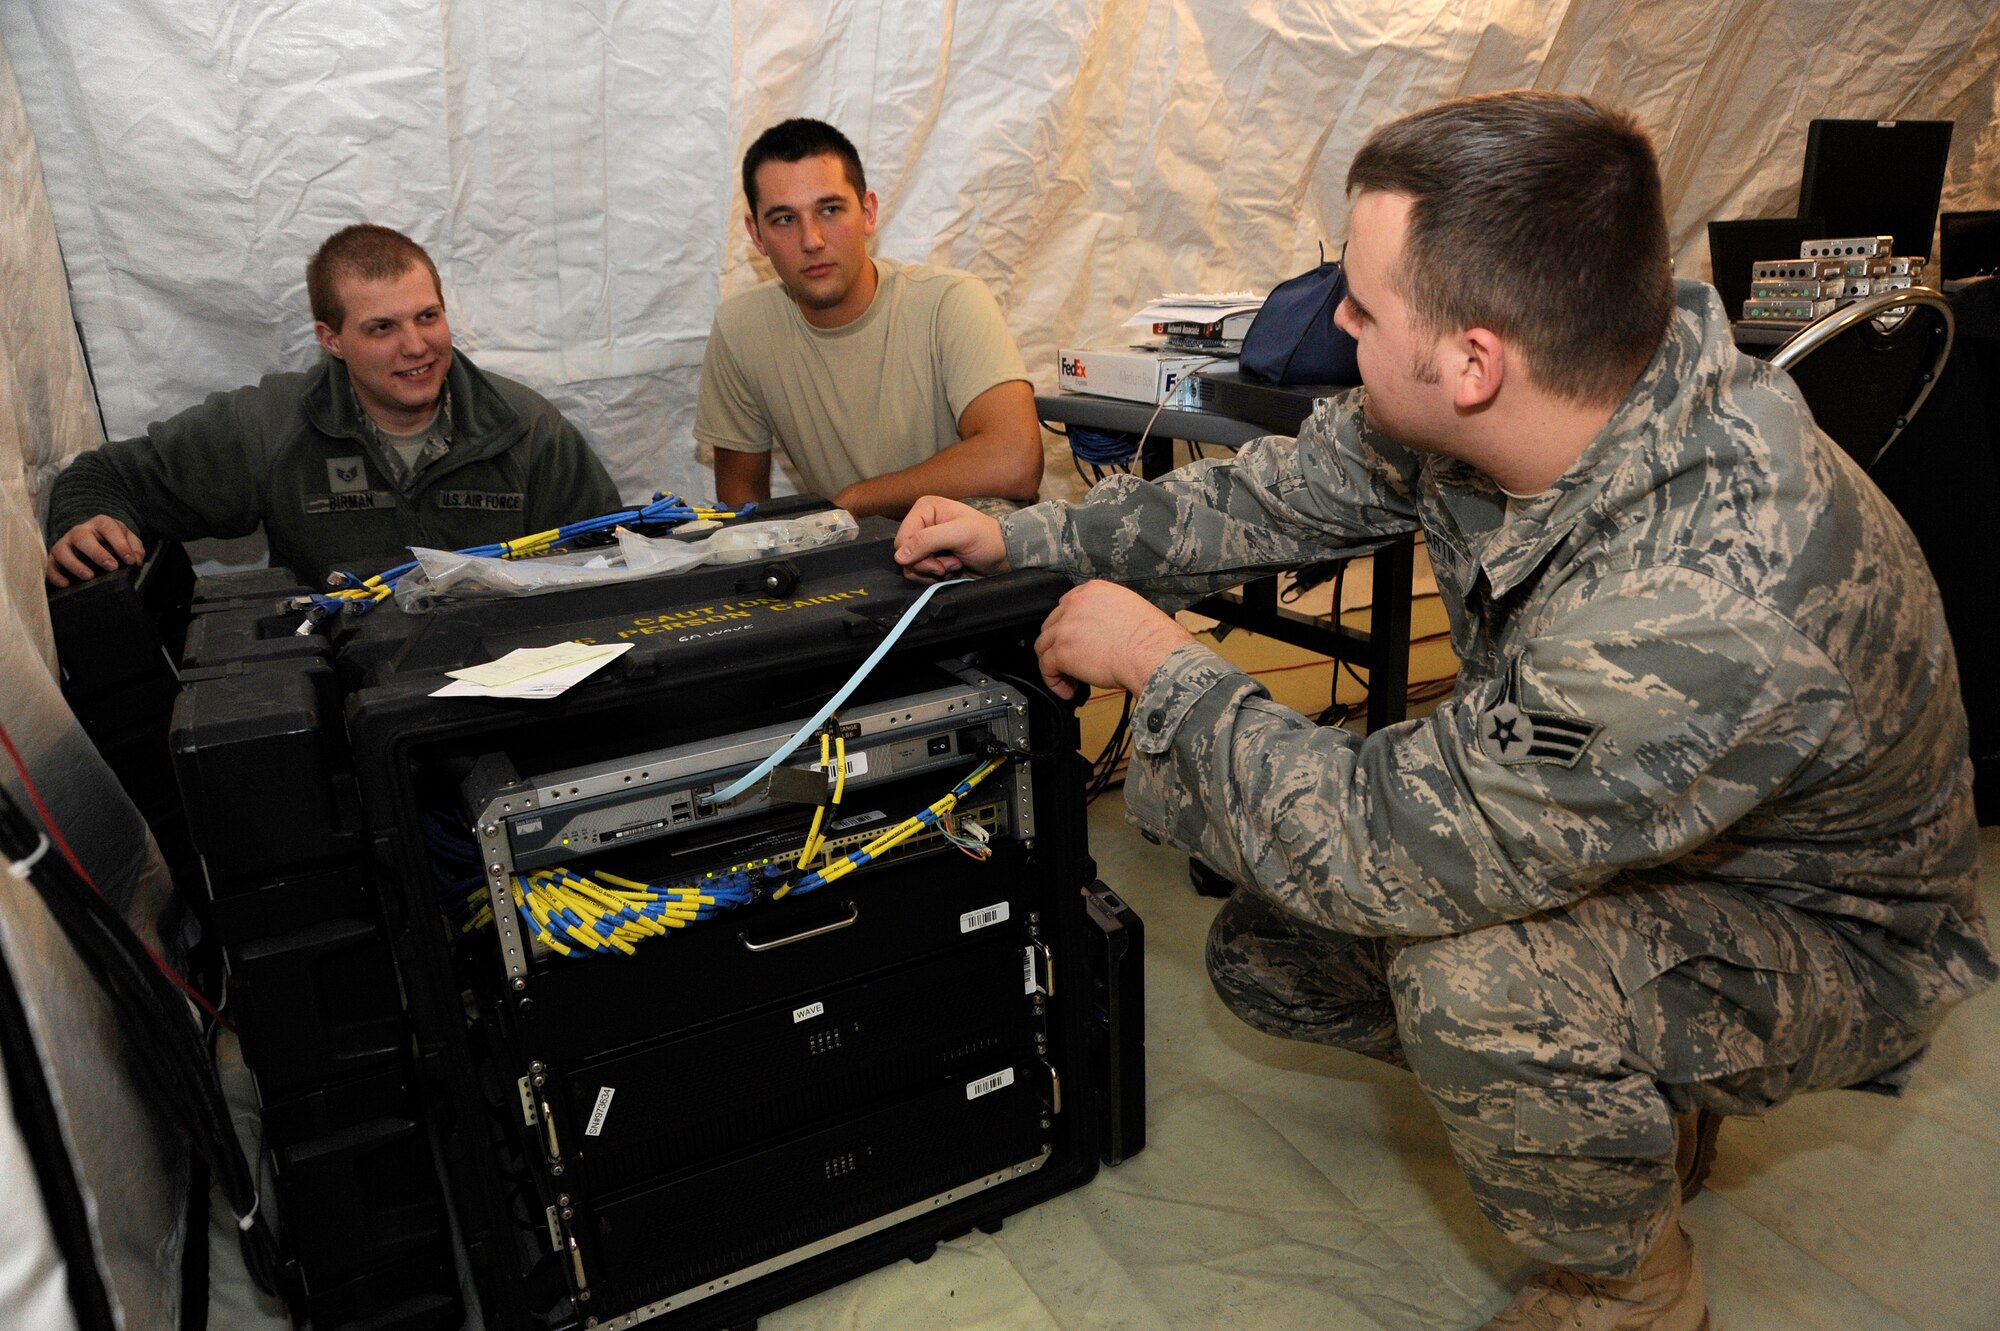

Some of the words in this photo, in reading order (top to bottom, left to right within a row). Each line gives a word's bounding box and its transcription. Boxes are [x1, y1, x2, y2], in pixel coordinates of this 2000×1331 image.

[1061, 357, 1087, 378] FedEx
[329, 493, 375, 511] BIRMAN
[442, 494, 459, 506] U.S.
[465, 495, 483, 507] AIR
[485, 496, 520, 509] FORCE
[617, 610, 752, 639] PERSON
[769, 588, 869, 612] CARRY
[633, 597, 781, 627] CAUTION
[588, 882, 603, 894] CISCO
[603, 891, 622, 904] SWITCH
[796, 1004, 822, 1019] WAVE
